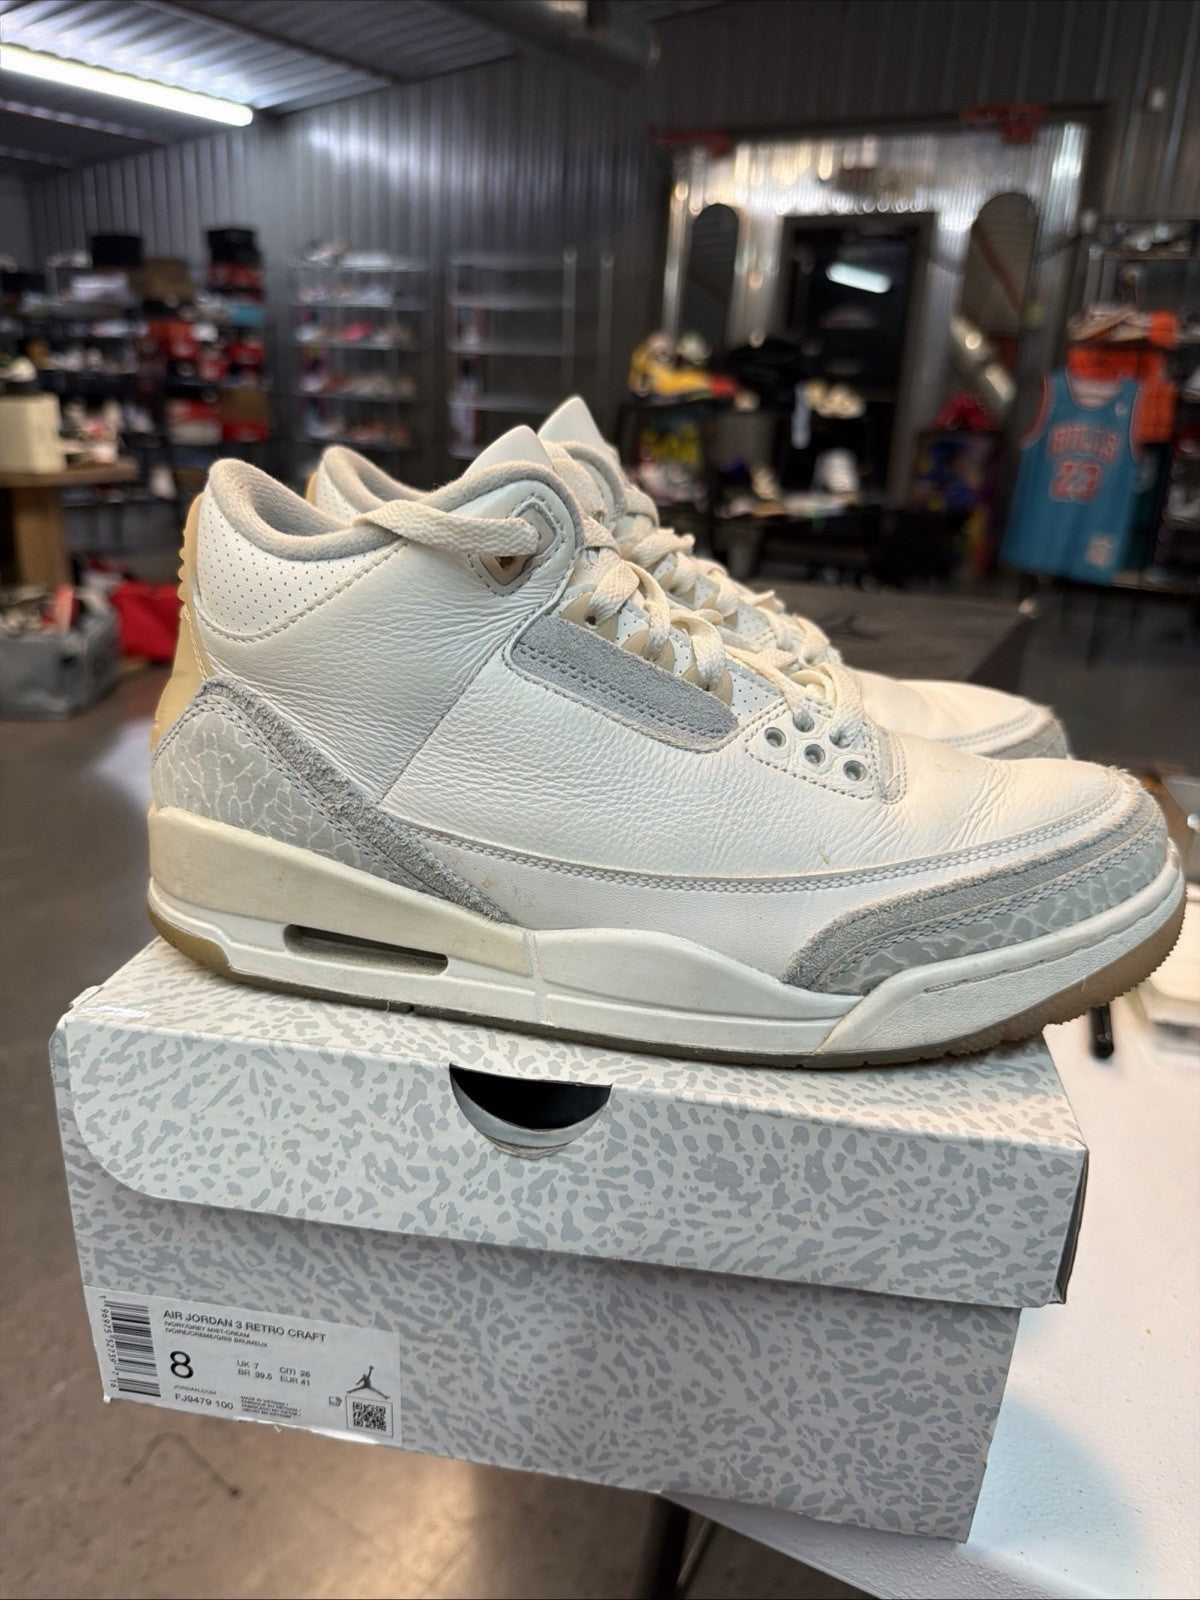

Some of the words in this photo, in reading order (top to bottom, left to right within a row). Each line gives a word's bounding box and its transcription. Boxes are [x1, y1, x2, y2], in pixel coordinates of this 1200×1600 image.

[163, 1310, 183, 1320] AIR
[185, 1313, 233, 1328] JORDAN
[235, 1320, 243, 1329] 3
[245, 1322, 285, 1336] RETRO
[287, 1328, 326, 1342] CRAFT
[170, 1350, 194, 1379] 8
[237, 1360, 250, 1368] UK
[254, 1362, 260, 1370] 7
[238, 1368, 251, 1377] BR
[254, 1371, 273, 1380] 39.5
[300, 1370, 311, 1378] 26
[280, 1375, 298, 1384] EUR
[300, 1378, 310, 1386] 41
[175, 1393, 212, 1406] FJ9479
[216, 1400, 234, 1410] 100
